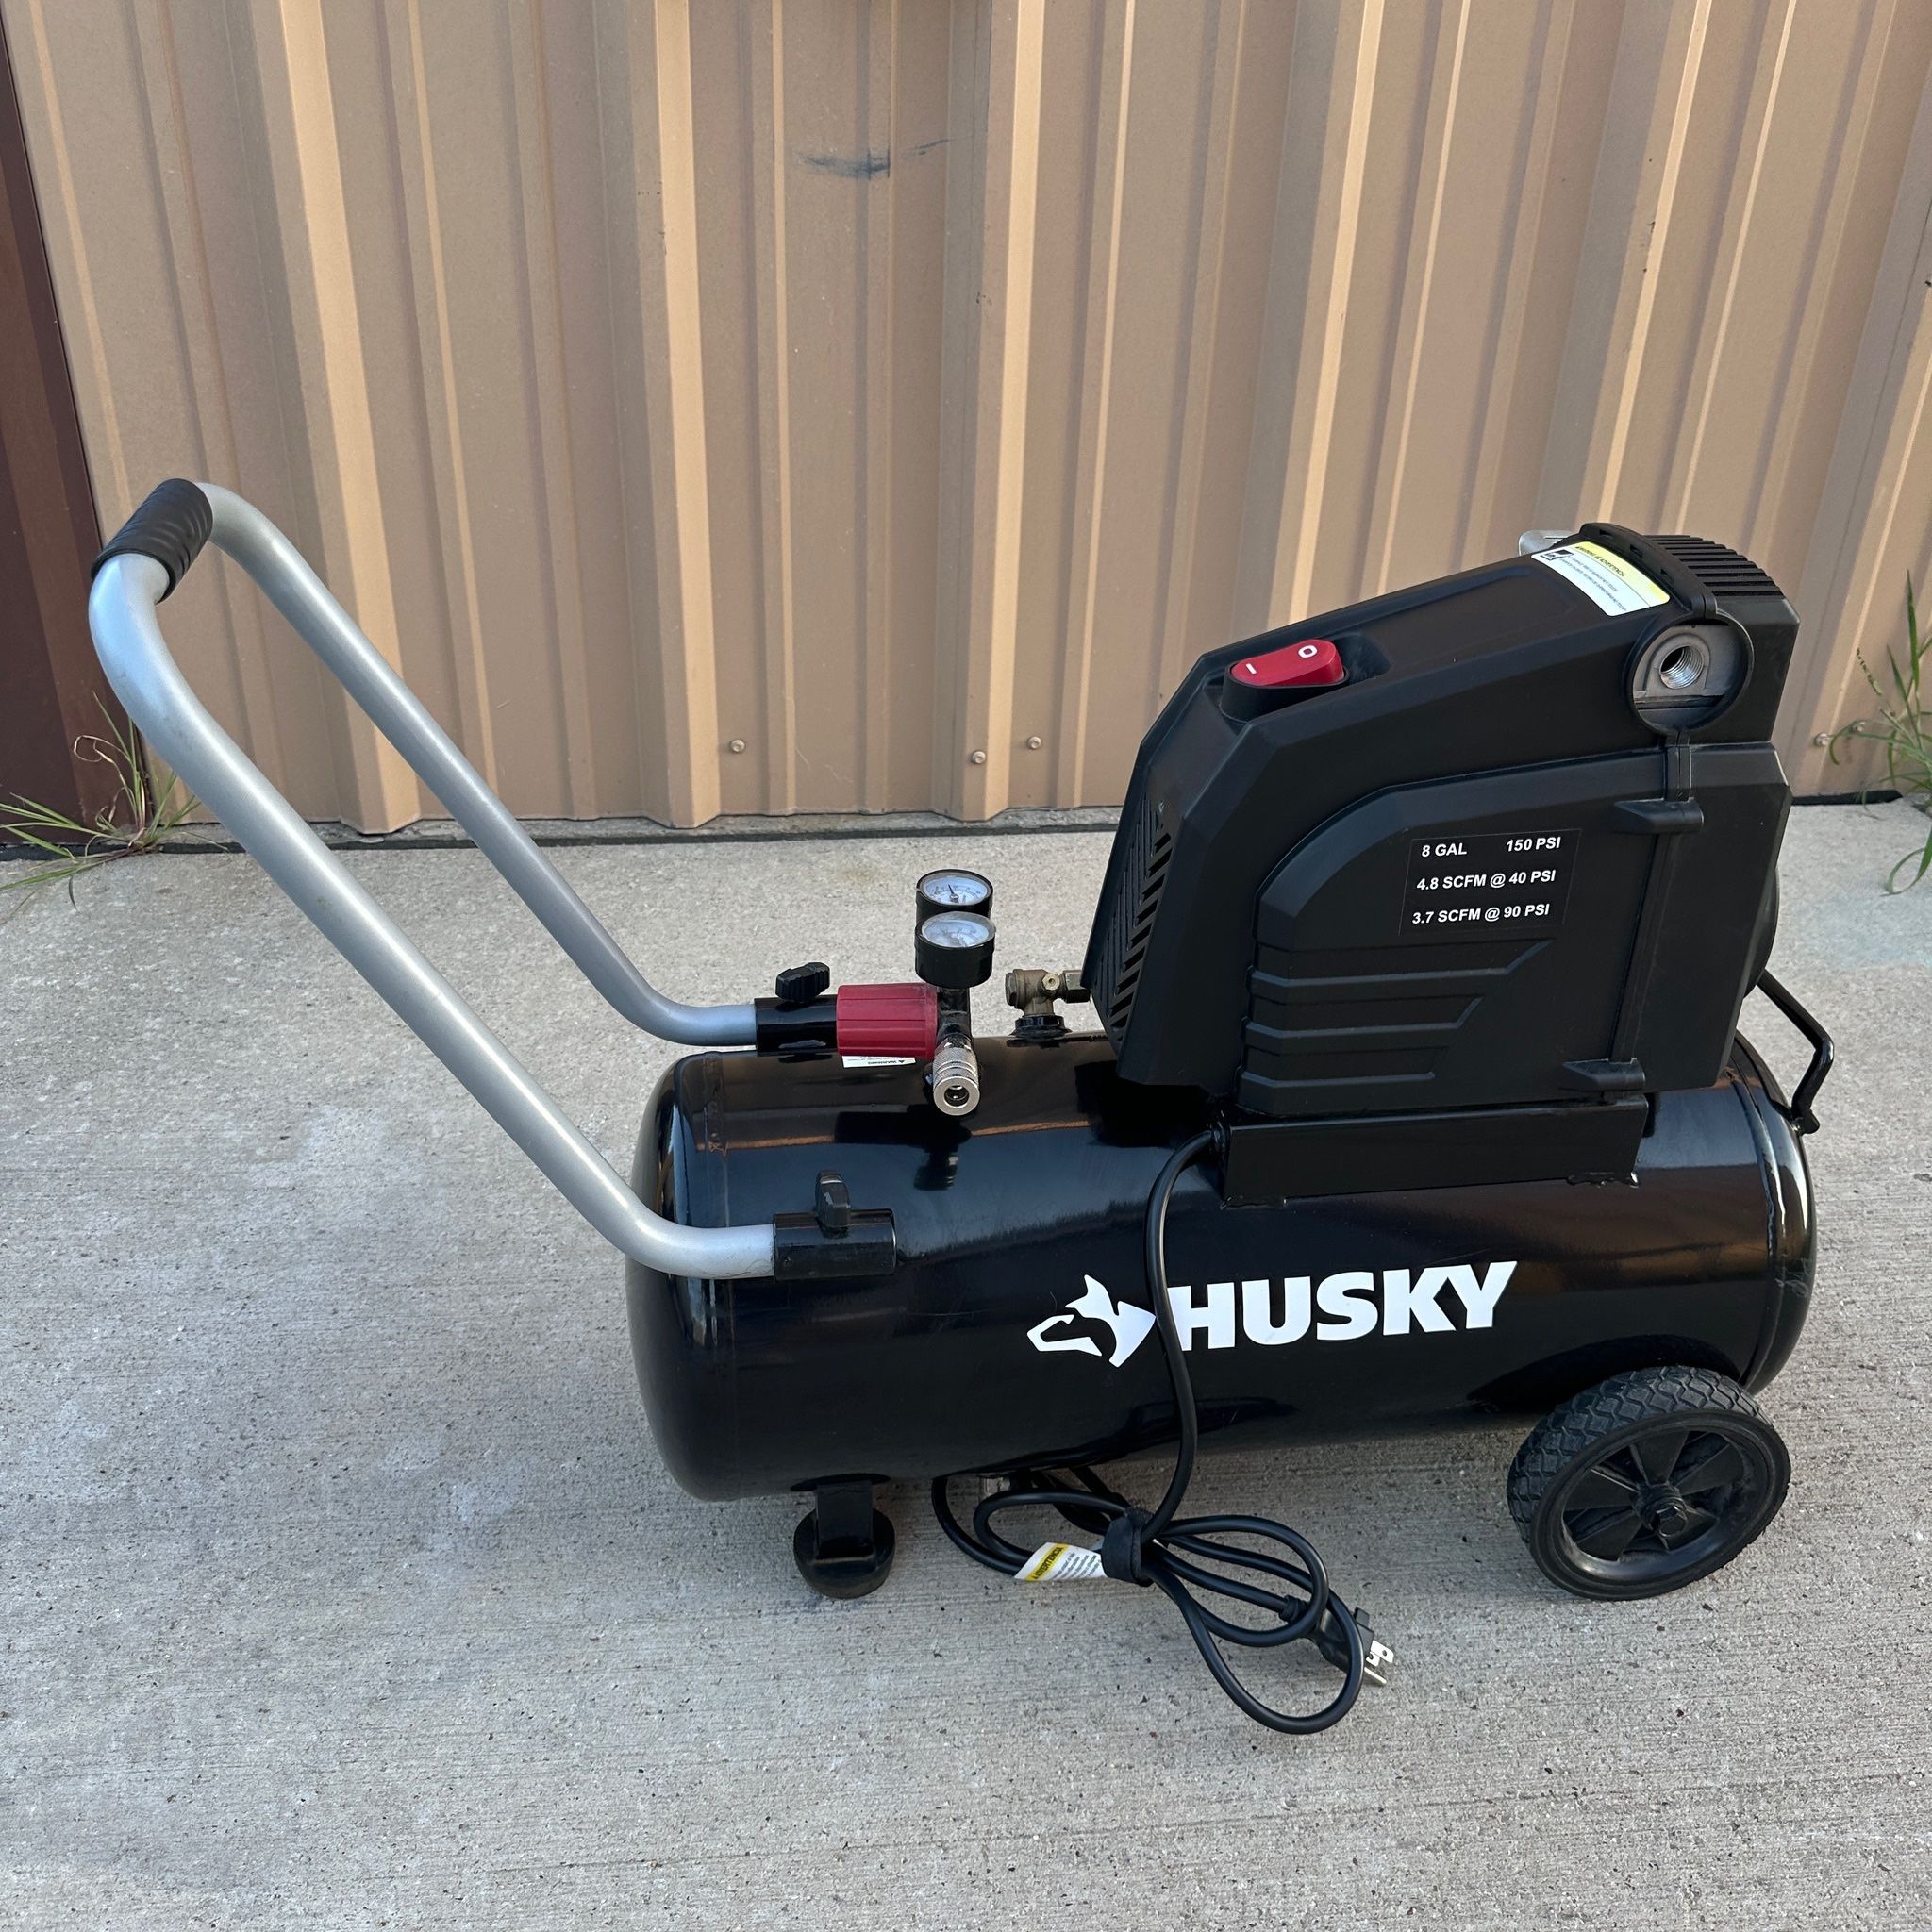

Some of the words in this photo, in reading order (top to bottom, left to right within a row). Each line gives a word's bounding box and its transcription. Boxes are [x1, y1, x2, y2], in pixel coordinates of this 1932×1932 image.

[1421, 844, 1431, 858] 8
[1434, 842, 1468, 857] GAL
[1507, 838, 1533, 852] 150
[1535, 836, 1561, 850] PSI
[1416, 876, 1440, 891] 4.8
[1441, 874, 1487, 890] SCFM
[1490, 873, 1507, 889] @
[1508, 871, 1527, 885] 40
[1530, 869, 1557, 884] PSI
[1411, 910, 1435, 924] 3.7
[1437, 908, 1481, 923] SCFM
[1484, 907, 1501, 923] @
[1503, 905, 1522, 919] 90
[1524, 903, 1550, 917] PSI
[1166, 1260, 1518, 1352] HUSKY
